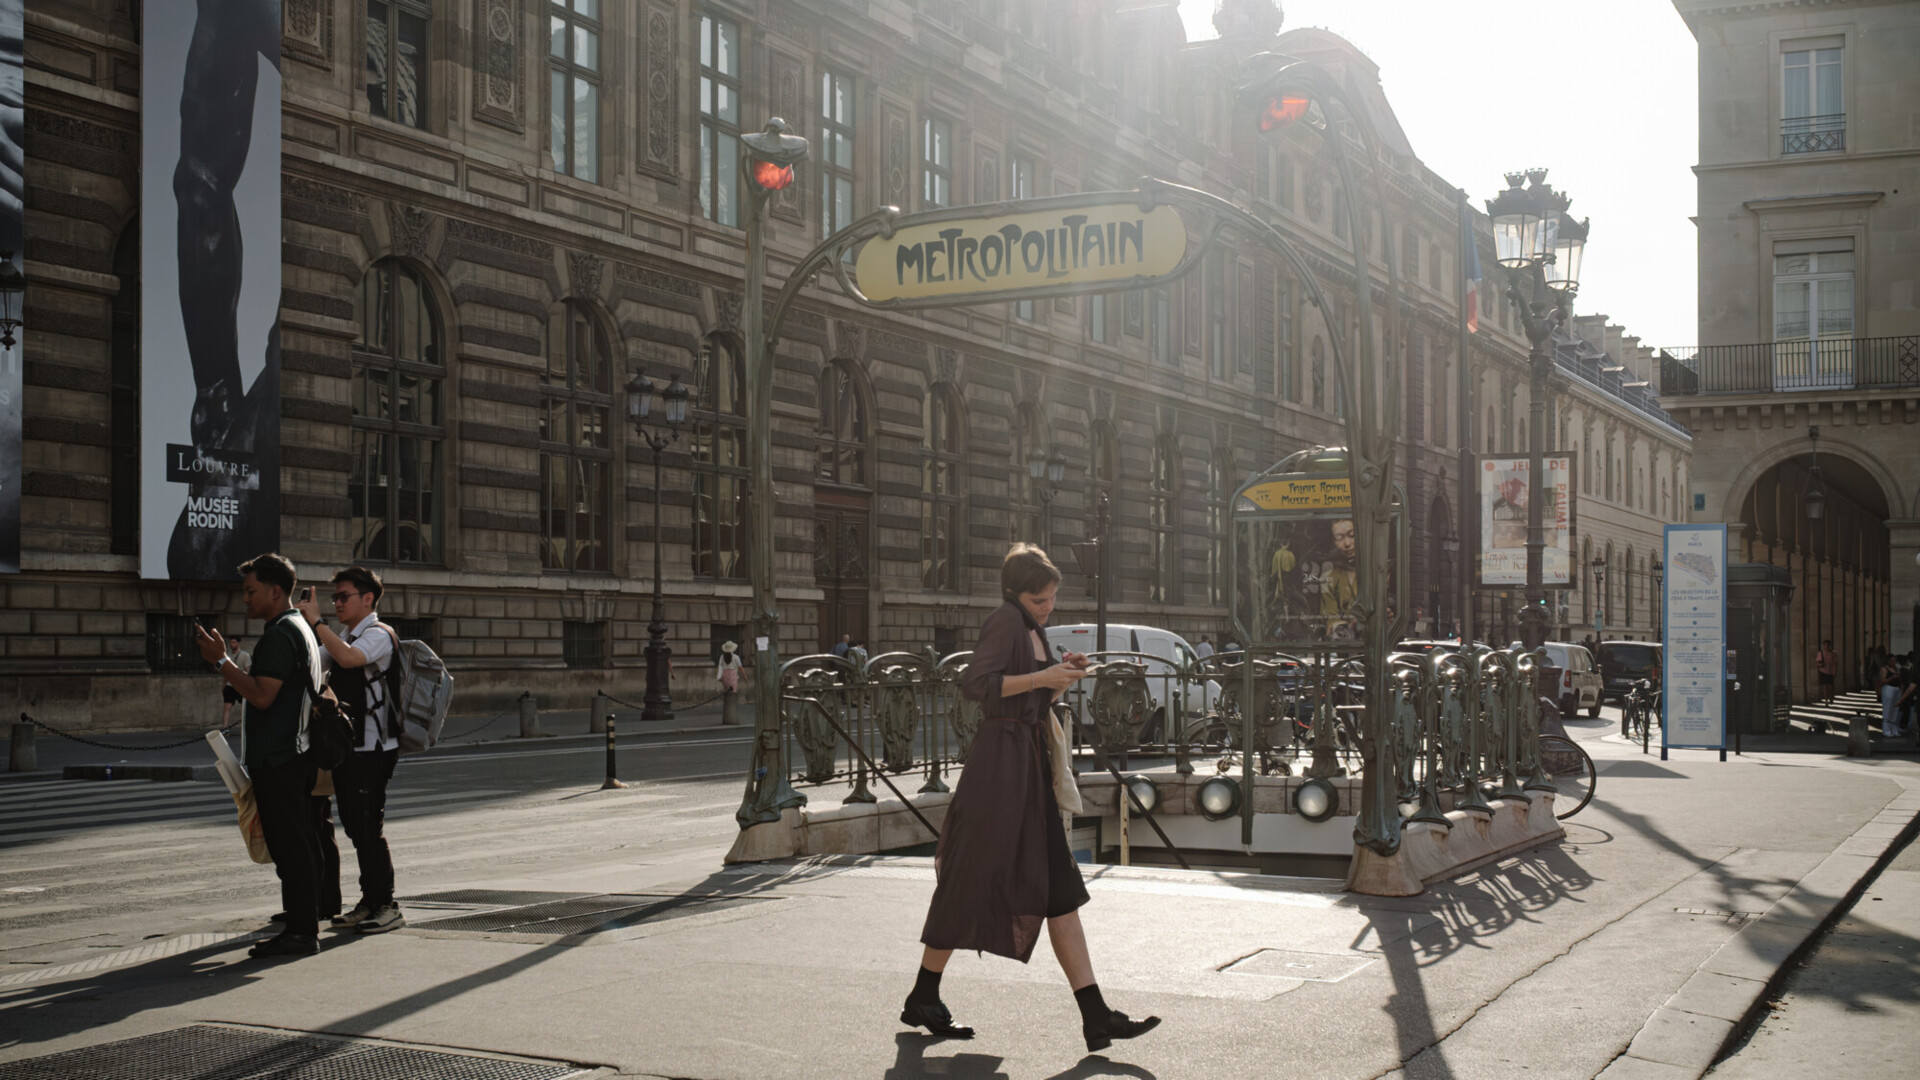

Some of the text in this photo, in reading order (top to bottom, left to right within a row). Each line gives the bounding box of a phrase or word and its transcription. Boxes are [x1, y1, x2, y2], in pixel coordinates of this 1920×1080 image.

[896, 214, 1144, 286] METROPOLITAIN
[178, 453, 250, 477] LOUVRE
[1549, 460, 1567, 471] DE
[1288, 481, 1349, 494] PALAIS ROYAL
[188, 496, 239, 515] MUSÉE
[1324, 494, 1352, 505] LOUVR
[1556, 483, 1567, 531] PAUME
[188, 513, 233, 529] RODIN
